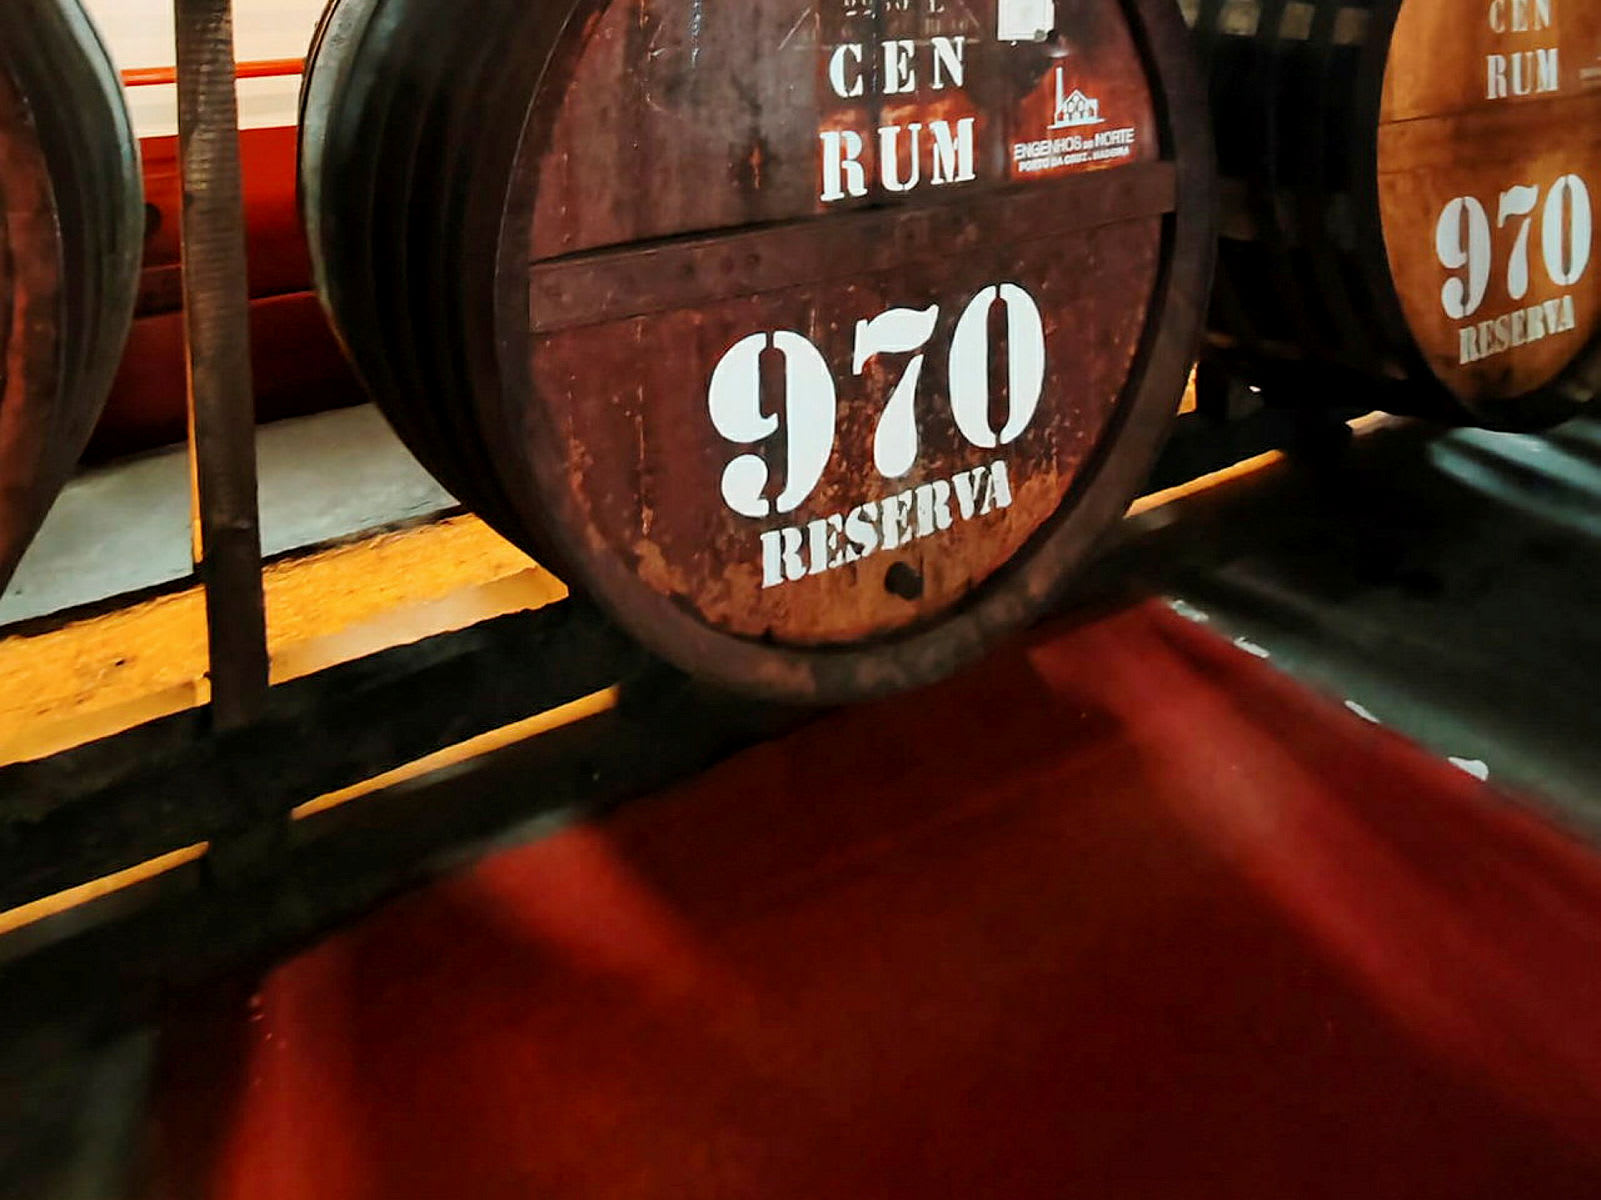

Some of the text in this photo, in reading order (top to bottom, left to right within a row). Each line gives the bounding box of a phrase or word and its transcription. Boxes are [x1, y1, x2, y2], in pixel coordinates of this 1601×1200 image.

[829, 36, 966, 98] CEN
[1486, 48, 1559, 100] RUM
[820, 117, 976, 202] RUM
[1013, 136, 1082, 161] ENGENHOS
[1094, 127, 1135, 148] NORTE
[1436, 174, 1592, 320] 970
[1459, 295, 1576, 365] RESERVA
[708, 282, 1046, 519] 970
[760, 459, 1012, 589] RESERVA
